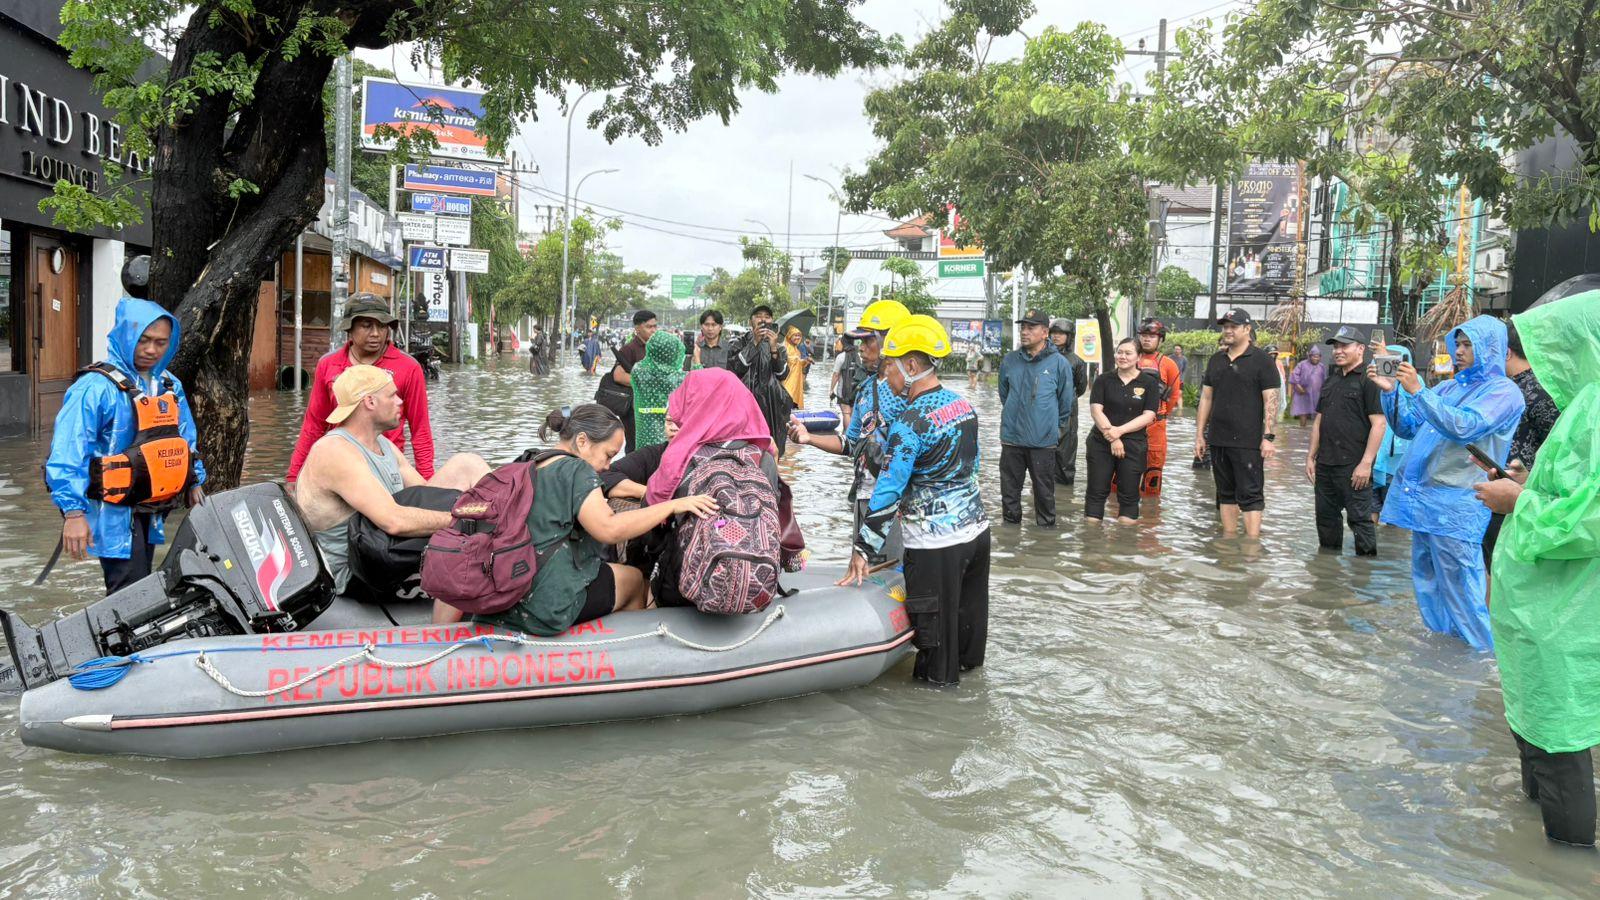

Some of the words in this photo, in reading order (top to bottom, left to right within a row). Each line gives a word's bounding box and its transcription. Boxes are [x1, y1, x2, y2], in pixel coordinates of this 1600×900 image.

[29, 151, 99, 193] LOUNGE
[415, 196, 431, 204] OPEN
[431, 196, 446, 212] 24
[446, 202, 469, 212] HOURS
[234, 510, 265, 561] SUZUKI
[272, 498, 295, 536] KEMENTERIAN
[290, 537, 306, 560] SOSIAL
[266, 662, 437, 702] REPUBLIK
[447, 650, 616, 691] INDONESIA
